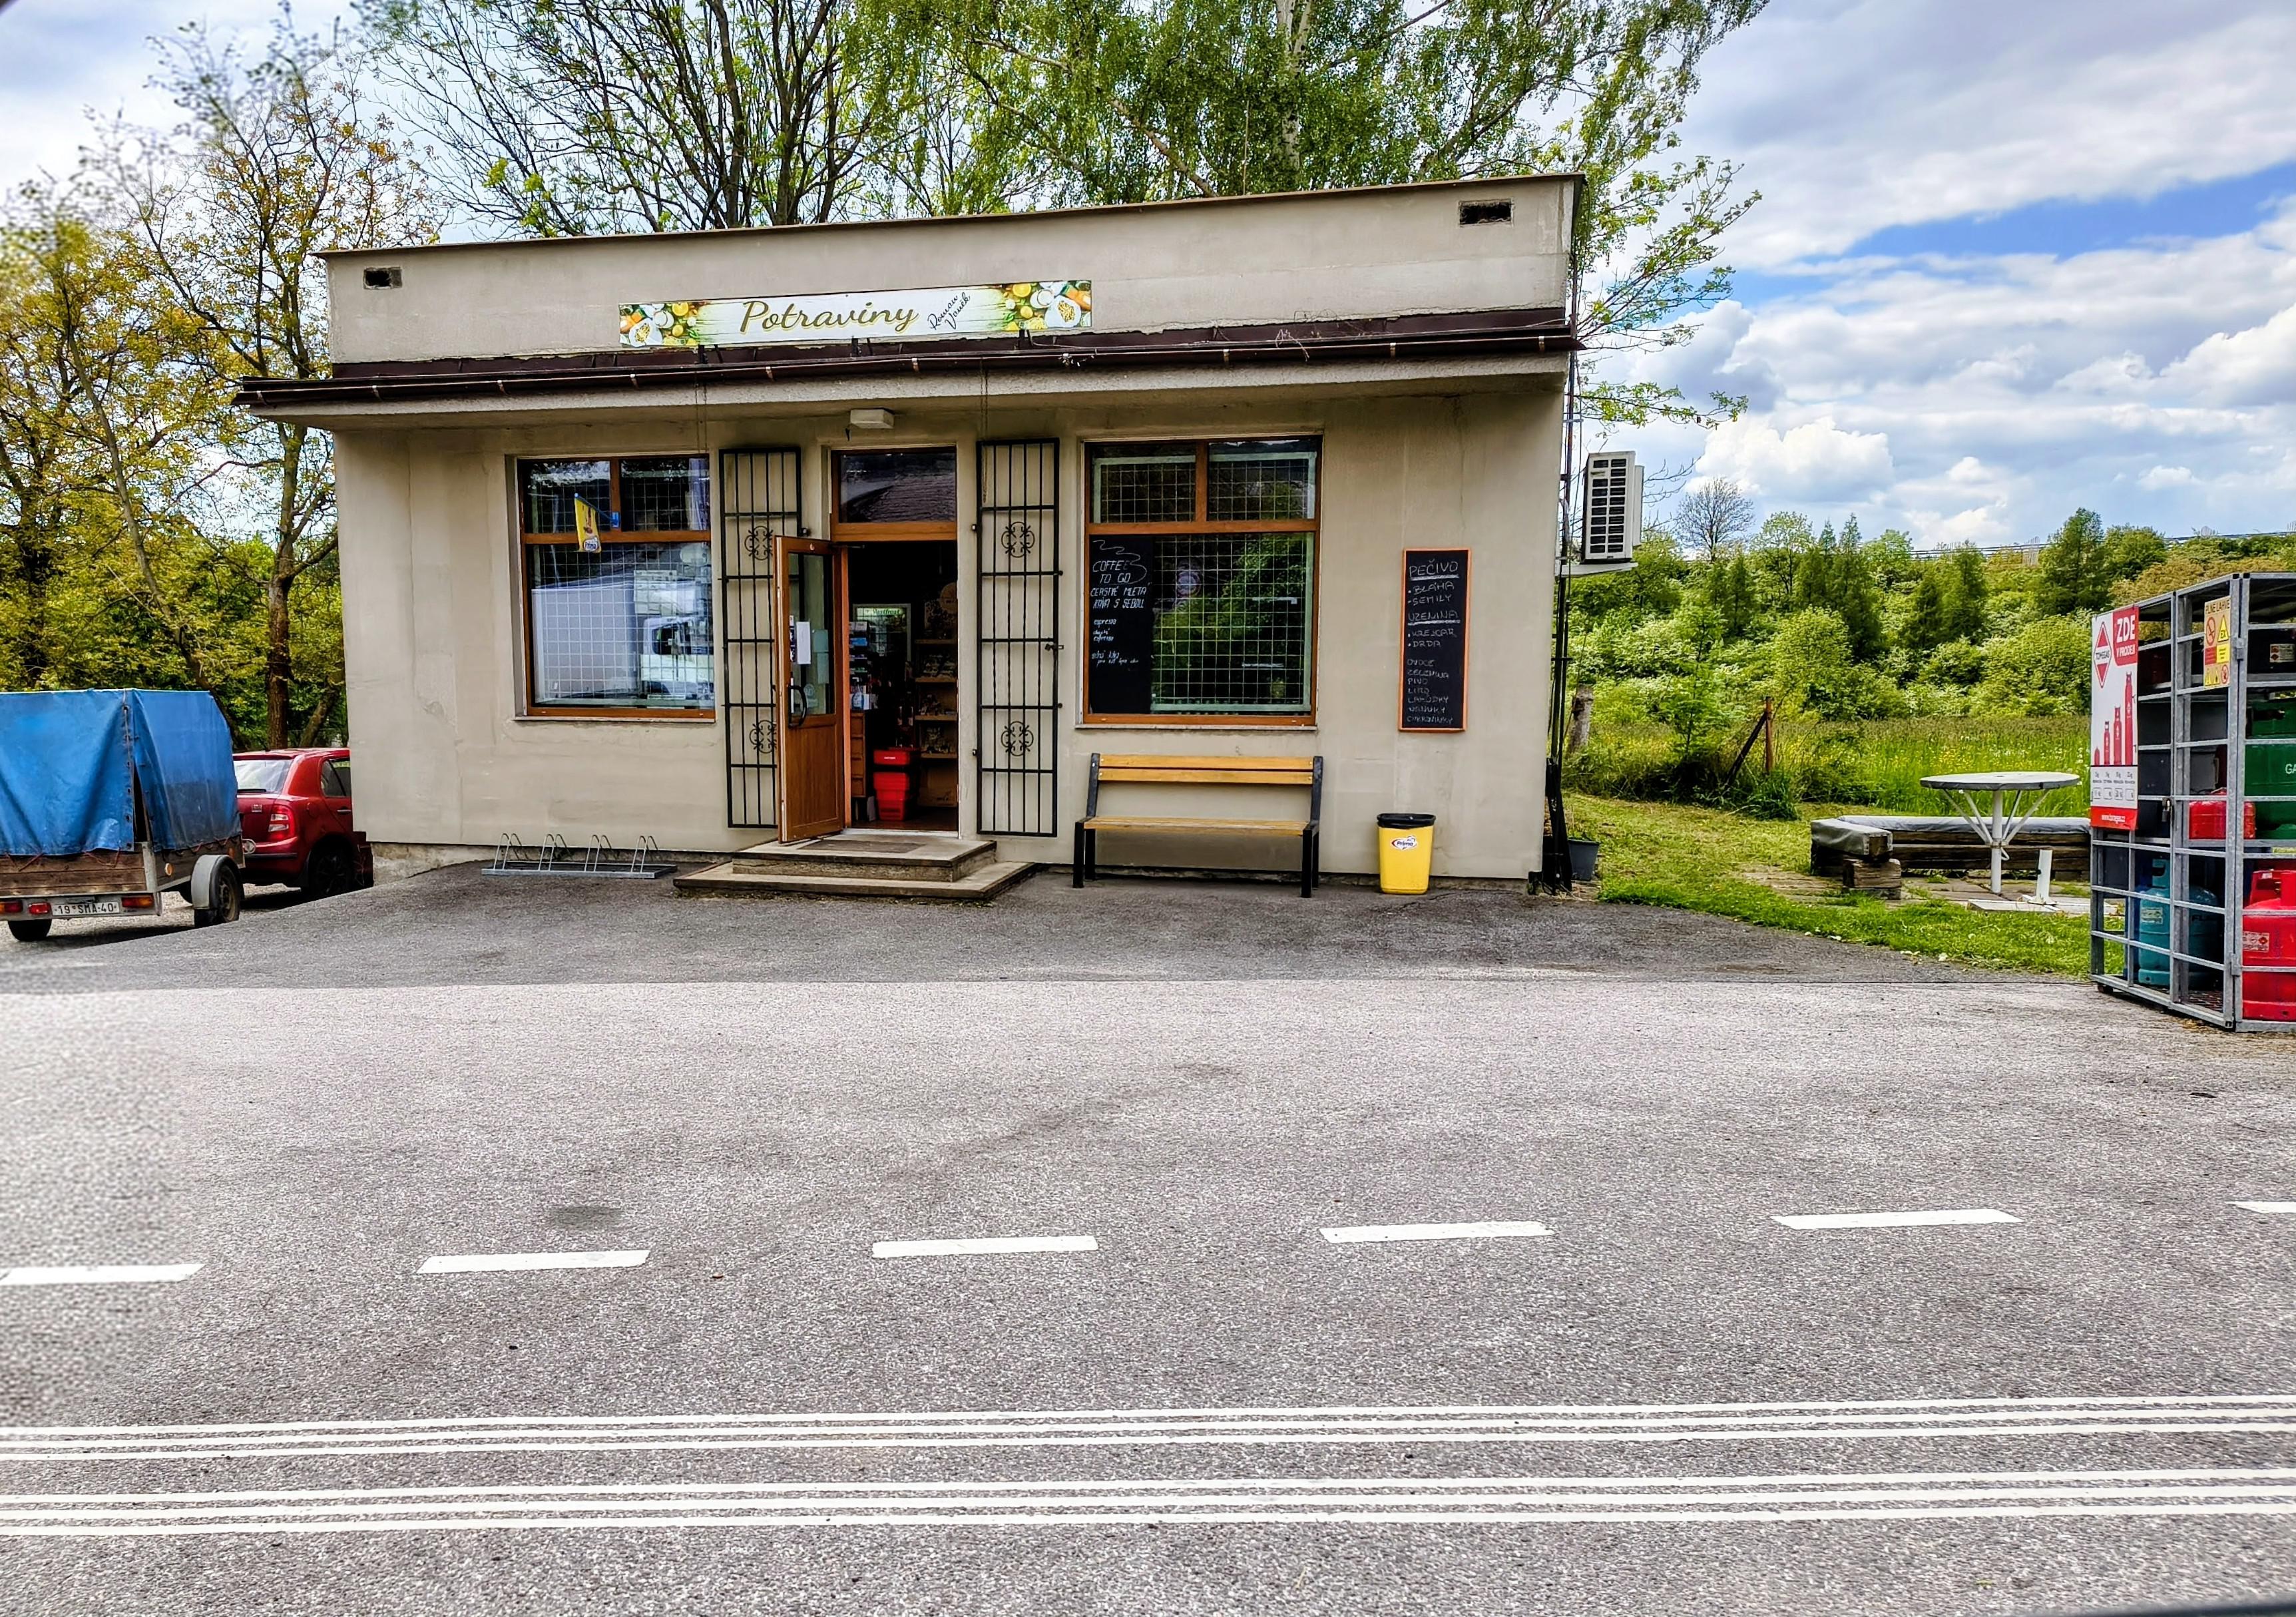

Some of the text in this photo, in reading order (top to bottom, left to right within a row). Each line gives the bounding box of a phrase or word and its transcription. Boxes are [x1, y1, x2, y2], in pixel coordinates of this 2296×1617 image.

[740, 300, 919, 334] Potraviny
[927, 295, 958, 330] Roman
[1092, 560, 1130, 572] COFFEE
[1409, 559, 1459, 578] PEČIVO
[1100, 573, 1131, 583] TO GO
[1113, 598, 1120, 608] S
[2116, 614, 2136, 643] ZDE
